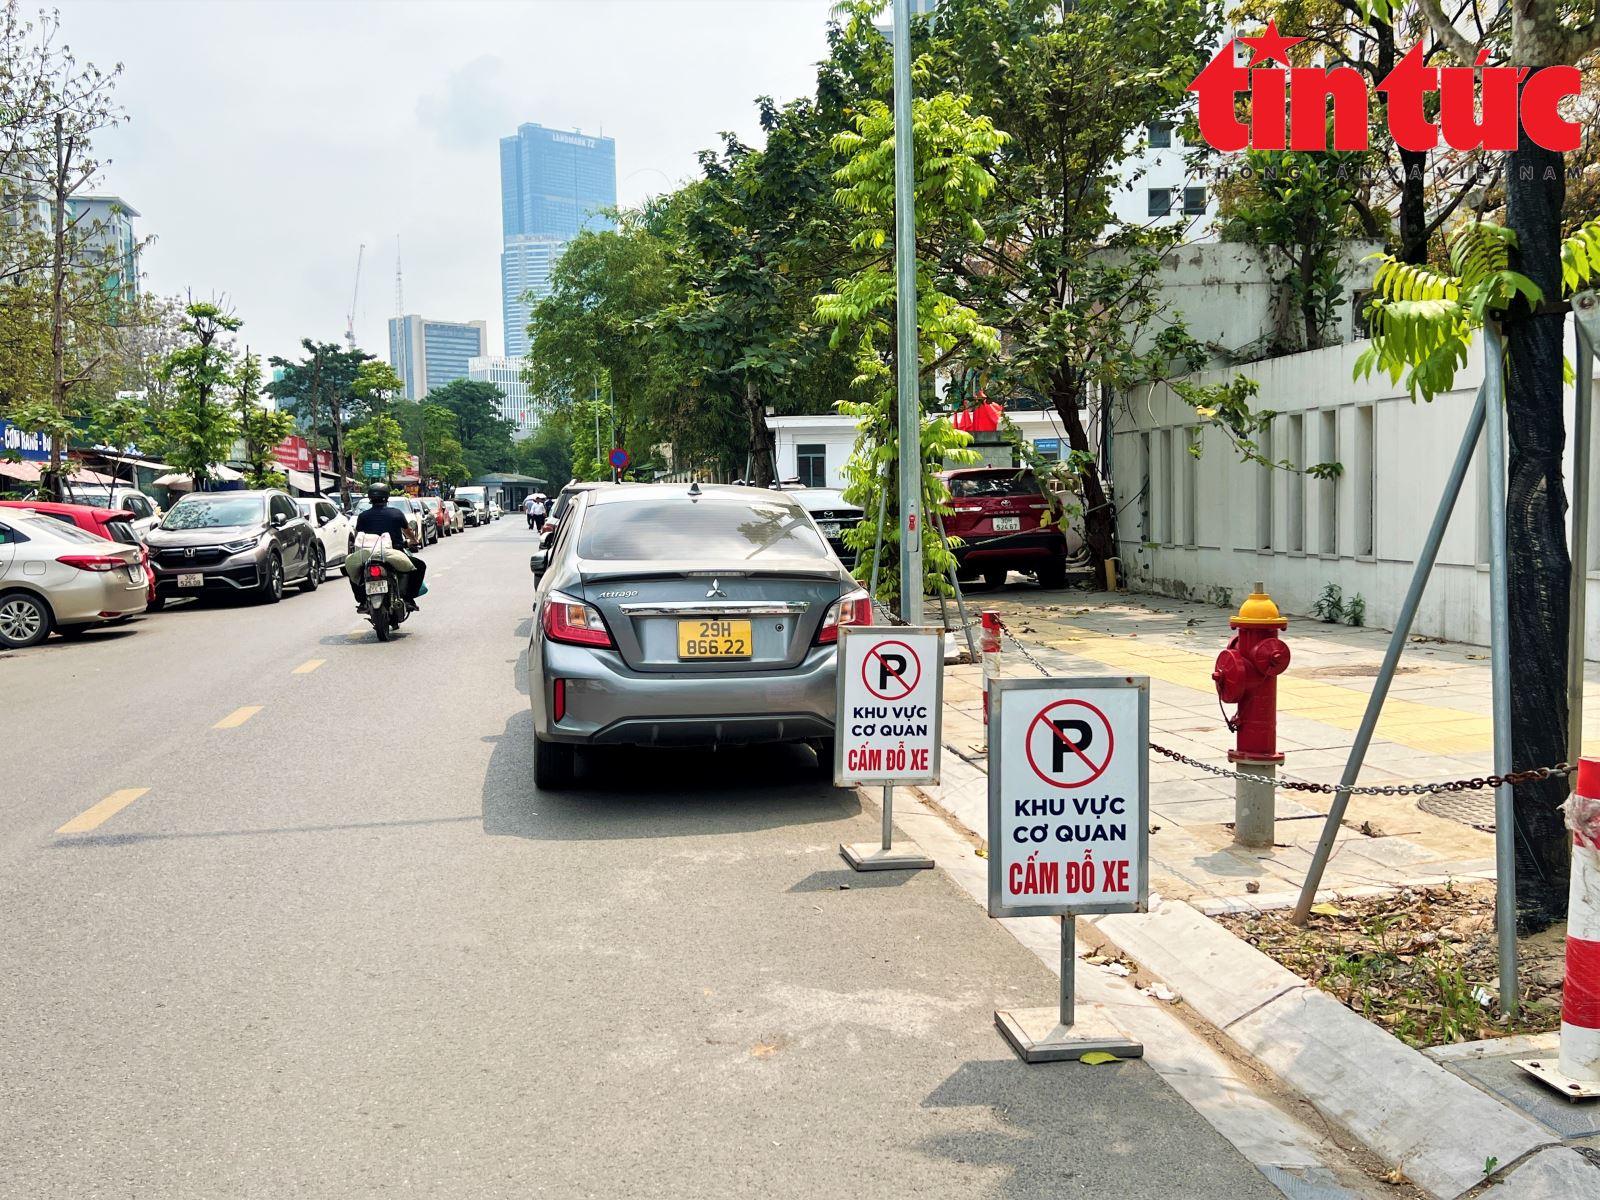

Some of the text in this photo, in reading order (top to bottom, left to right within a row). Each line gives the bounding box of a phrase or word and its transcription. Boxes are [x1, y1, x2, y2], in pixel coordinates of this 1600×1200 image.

[699, 621, 731, 638] 29H
[686, 639, 745, 655] 866.22
[853, 705, 927, 721] KHU VỰC
[851, 724, 928, 737] CƠ QUAN
[848, 741, 929, 771] CẤM ĐỖ XE
[1015, 795, 1126, 819] KHU VỰC
[1013, 823, 1127, 843] CƠ QUAN
[1009, 849, 1130, 895] CẤM ĐỖ XE
